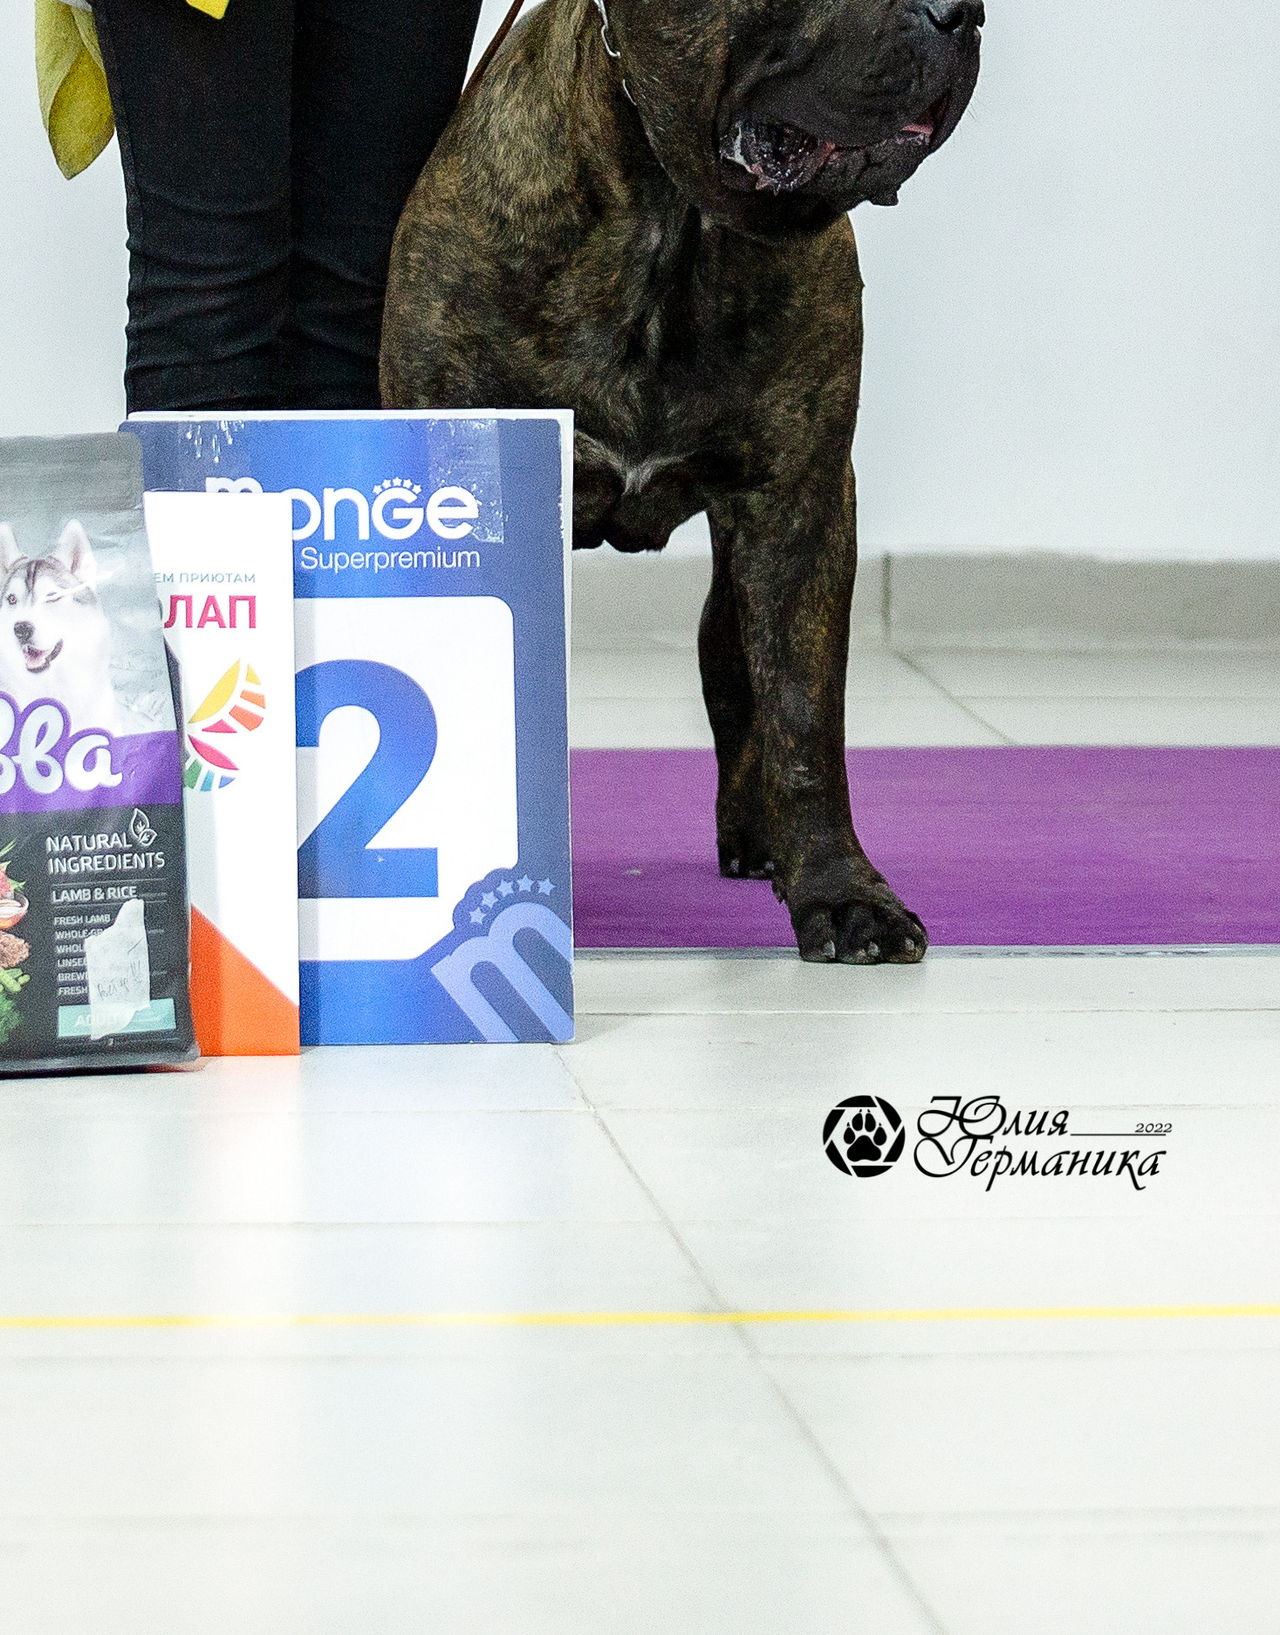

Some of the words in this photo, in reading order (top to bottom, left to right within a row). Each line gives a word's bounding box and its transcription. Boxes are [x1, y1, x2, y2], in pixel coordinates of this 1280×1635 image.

[300, 546, 481, 574] Superpremium
[179, 572, 256, 584] ПРИЮТАМ
[163, 594, 257, 630] ЛАП
[295, 658, 438, 899] 2
[46, 832, 132, 852] NATURAL
[49, 852, 166, 874] INGREDIENTS
[52, 887, 91, 903] LAMB
[95, 887, 105, 900] &
[107, 886, 138, 900] RICE
[54, 916, 83, 926] FRESH
[85, 914, 111, 924] LAMB
[56, 943, 86, 954] WHOL
